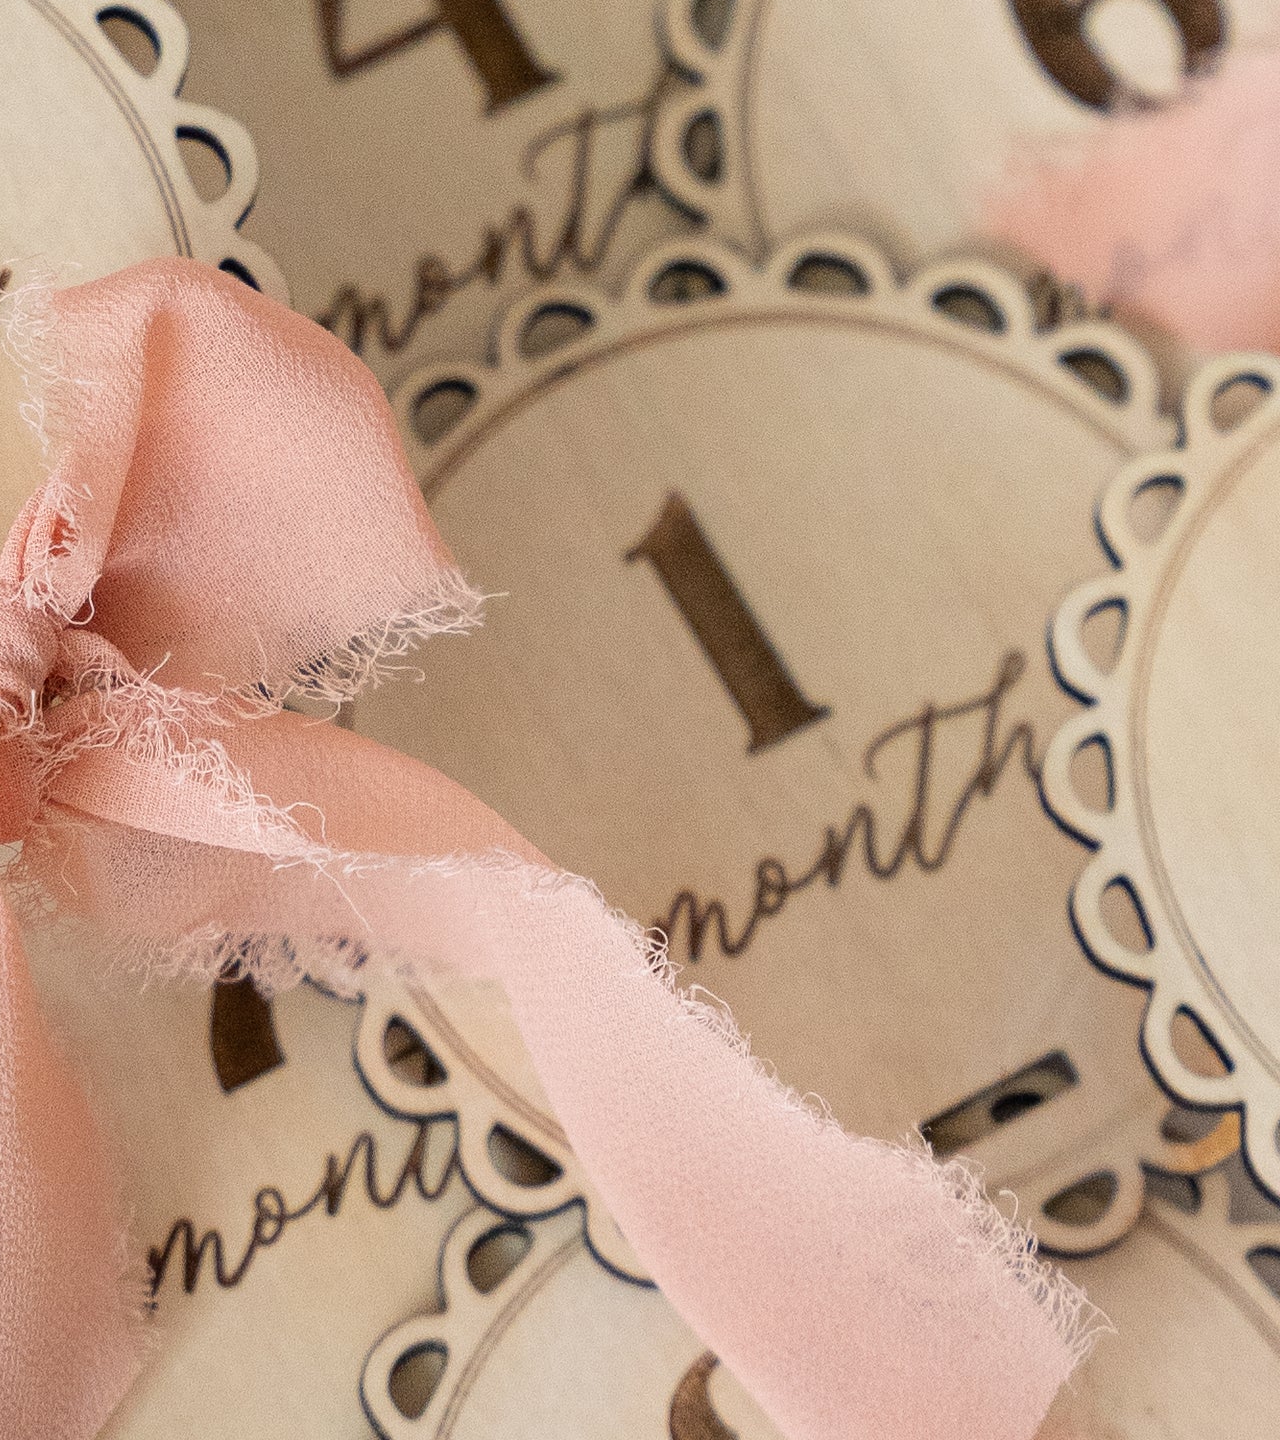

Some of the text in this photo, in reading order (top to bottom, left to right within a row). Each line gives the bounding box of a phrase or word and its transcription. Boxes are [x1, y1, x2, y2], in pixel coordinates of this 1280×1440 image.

[315, 75, 665, 360] mont
[624, 488, 832, 757] 1
[648, 648, 1045, 975] month
[148, 1120, 462, 1305] mon
